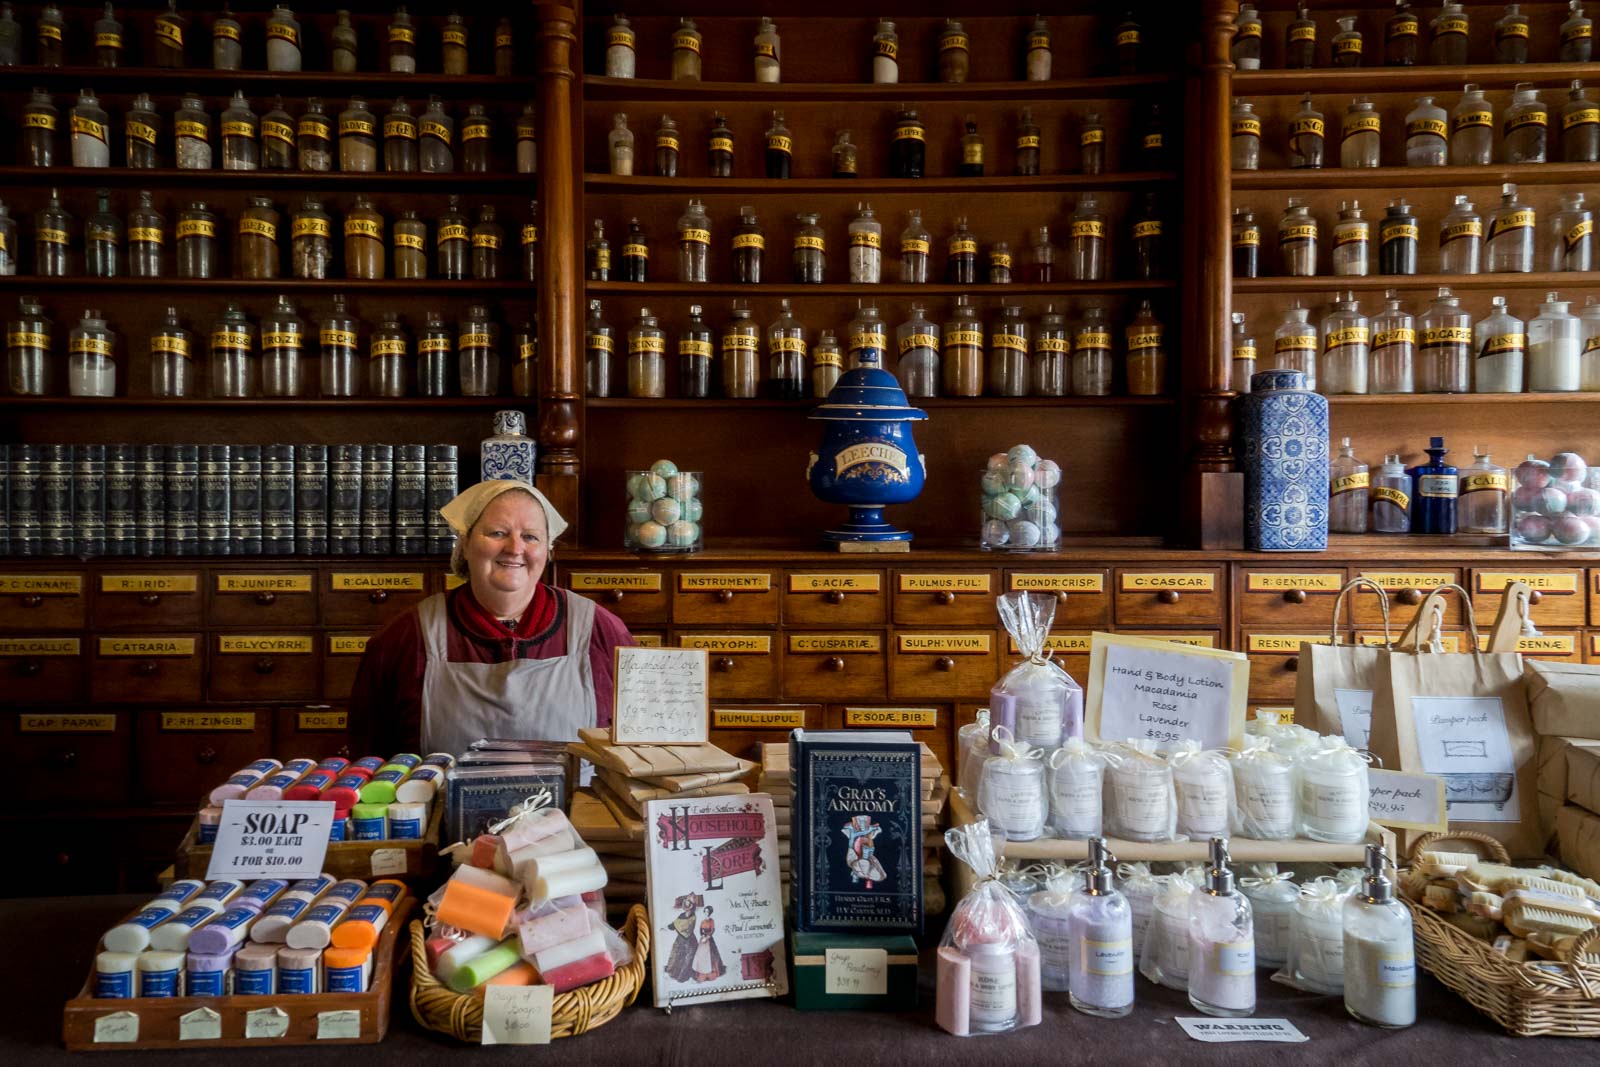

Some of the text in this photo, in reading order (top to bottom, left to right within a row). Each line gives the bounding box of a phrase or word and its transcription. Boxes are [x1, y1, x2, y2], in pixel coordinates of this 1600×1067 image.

[1378, 577, 1446, 586] HIERA PICRA
[1258, 639, 1296, 649] RESIN:
[1112, 666, 1142, 678] Hand
[1144, 671, 1153, 681] &
[1156, 672, 1184, 687] Body
[1134, 684, 1199, 700] Macadamia
[1152, 701, 1178, 712] Rose
[1139, 713, 1190, 729] Lavender
[1392, 787, 1422, 800] pack
[827, 800, 897, 813] ANATOMY
[243, 813, 309, 835] SOAP
[240, 836, 303, 847] $3.00 EACH
[232, 856, 303, 866] 4 FOR $10.00
[1193, 1023, 1285, 1032] WARNING
